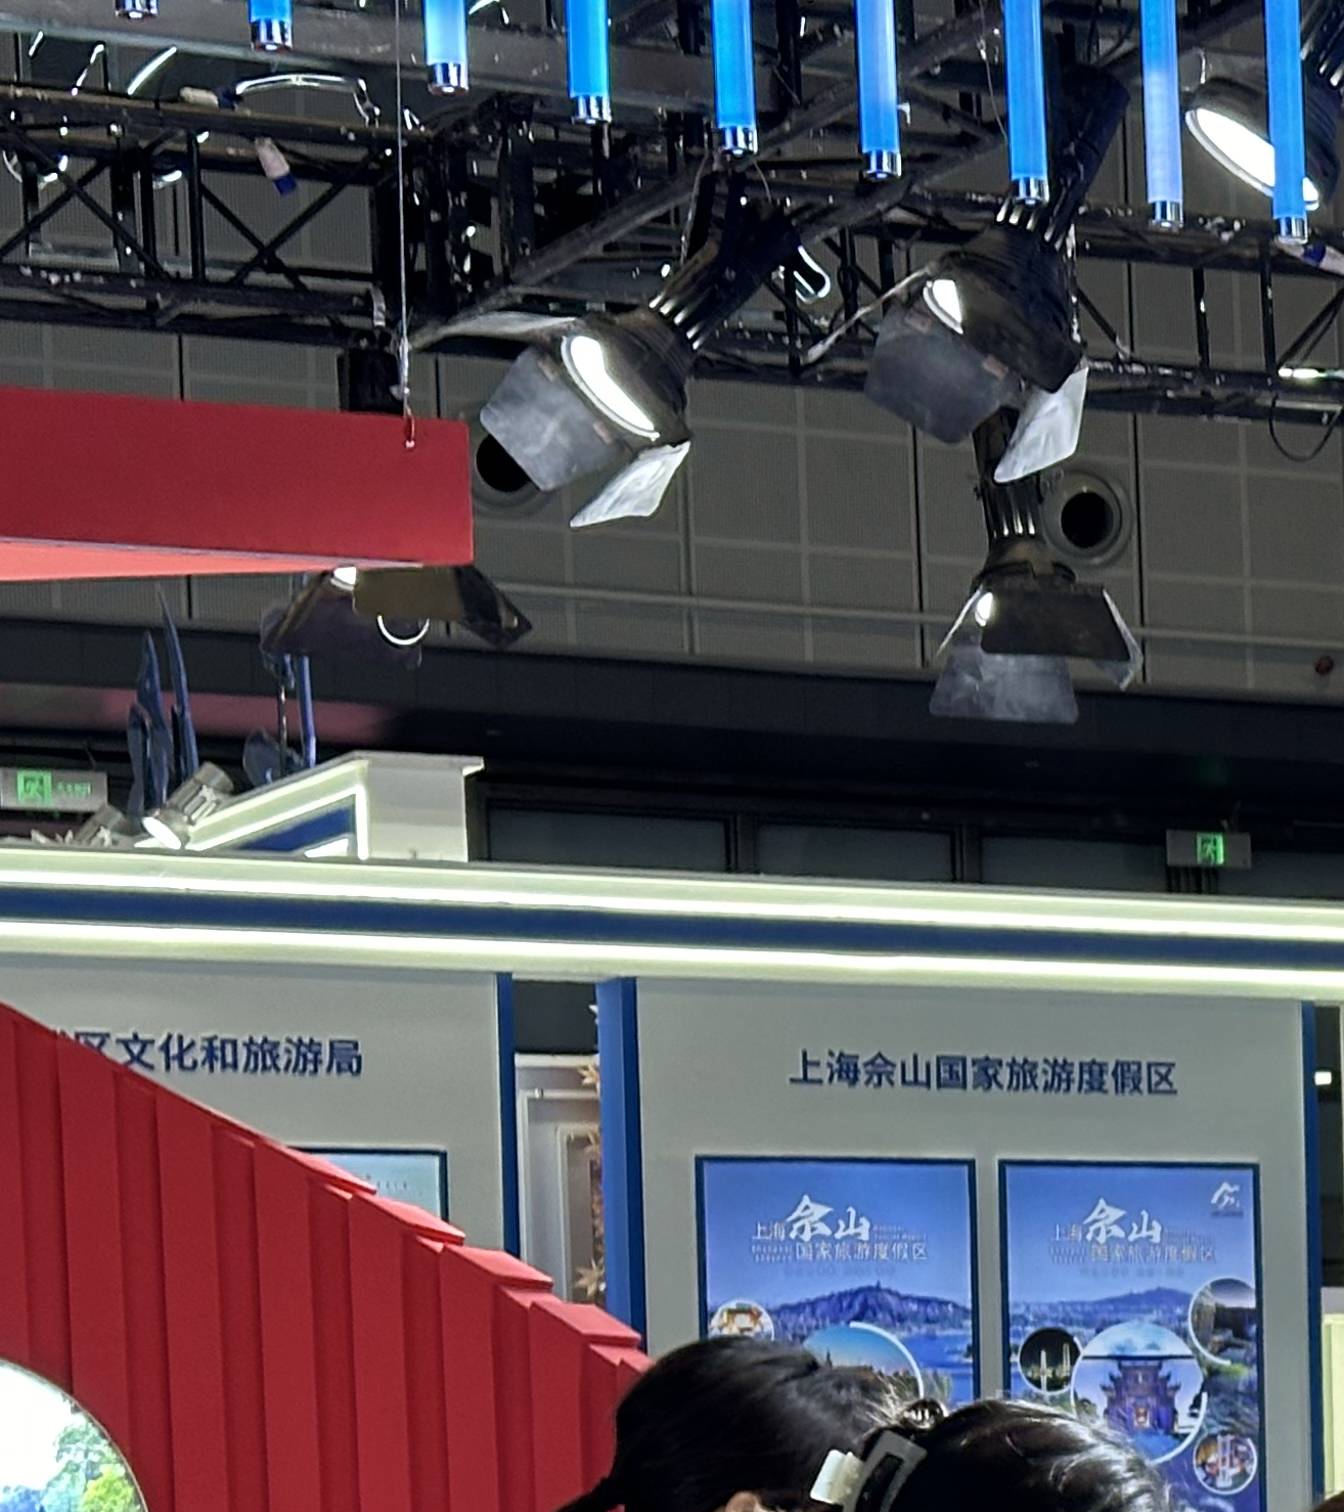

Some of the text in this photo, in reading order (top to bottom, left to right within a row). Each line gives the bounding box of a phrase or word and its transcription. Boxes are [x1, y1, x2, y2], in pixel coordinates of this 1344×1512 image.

[57, 1031, 362, 1077] 区文化和旅游局
[789, 1048, 1178, 1096] 上海佘山国家旅游度假区
